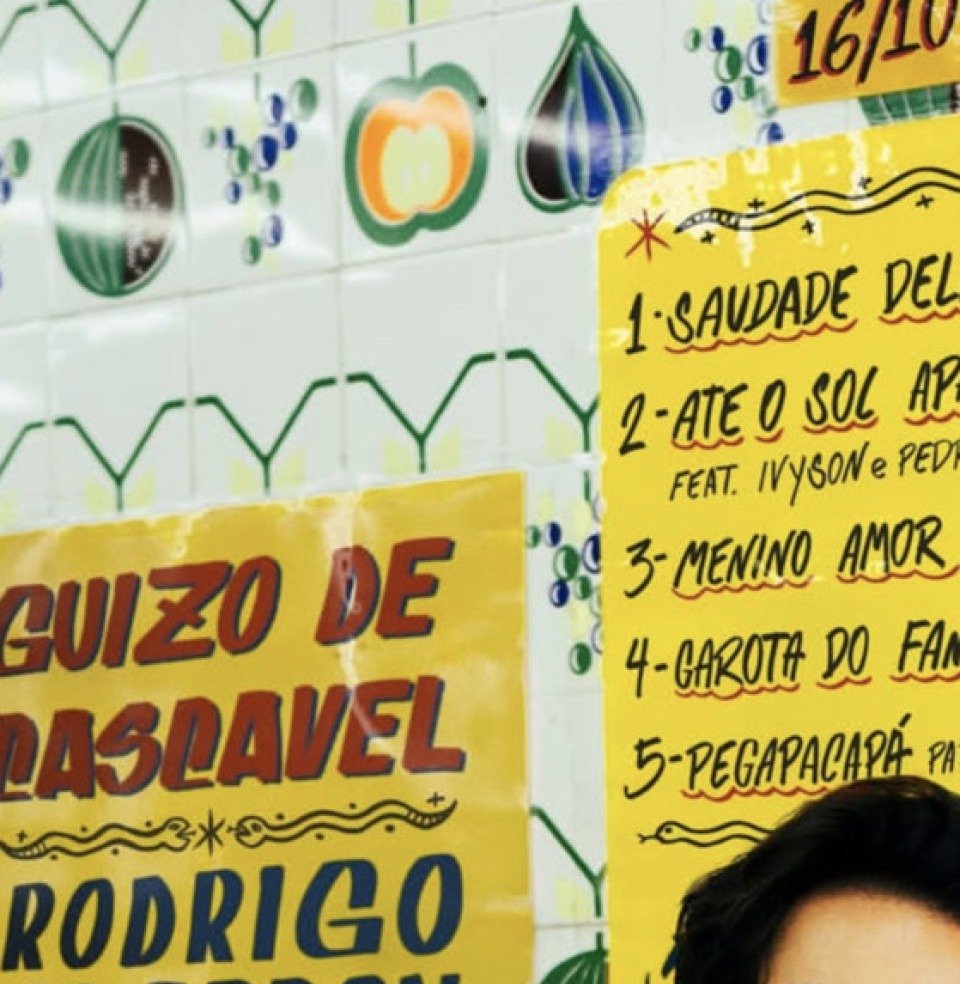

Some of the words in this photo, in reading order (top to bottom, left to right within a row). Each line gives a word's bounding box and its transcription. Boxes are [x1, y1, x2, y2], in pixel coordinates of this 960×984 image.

[788, 0, 959, 84] 16/10
[666, 265, 859, 345] SAUDADE
[758, 379, 787, 432] O
[804, 366, 879, 426] SOL
[668, 464, 739, 501] FEAT.
[672, 530, 813, 588] MENINO
[836, 515, 946, 576] AMOR
[0, 556, 283, 677] GUIZO
[315, 538, 456, 648] DE
[673, 630, 807, 690] GAROTA
[821, 625, 870, 680] DO
[2, 853, 463, 972] RODRIGO
